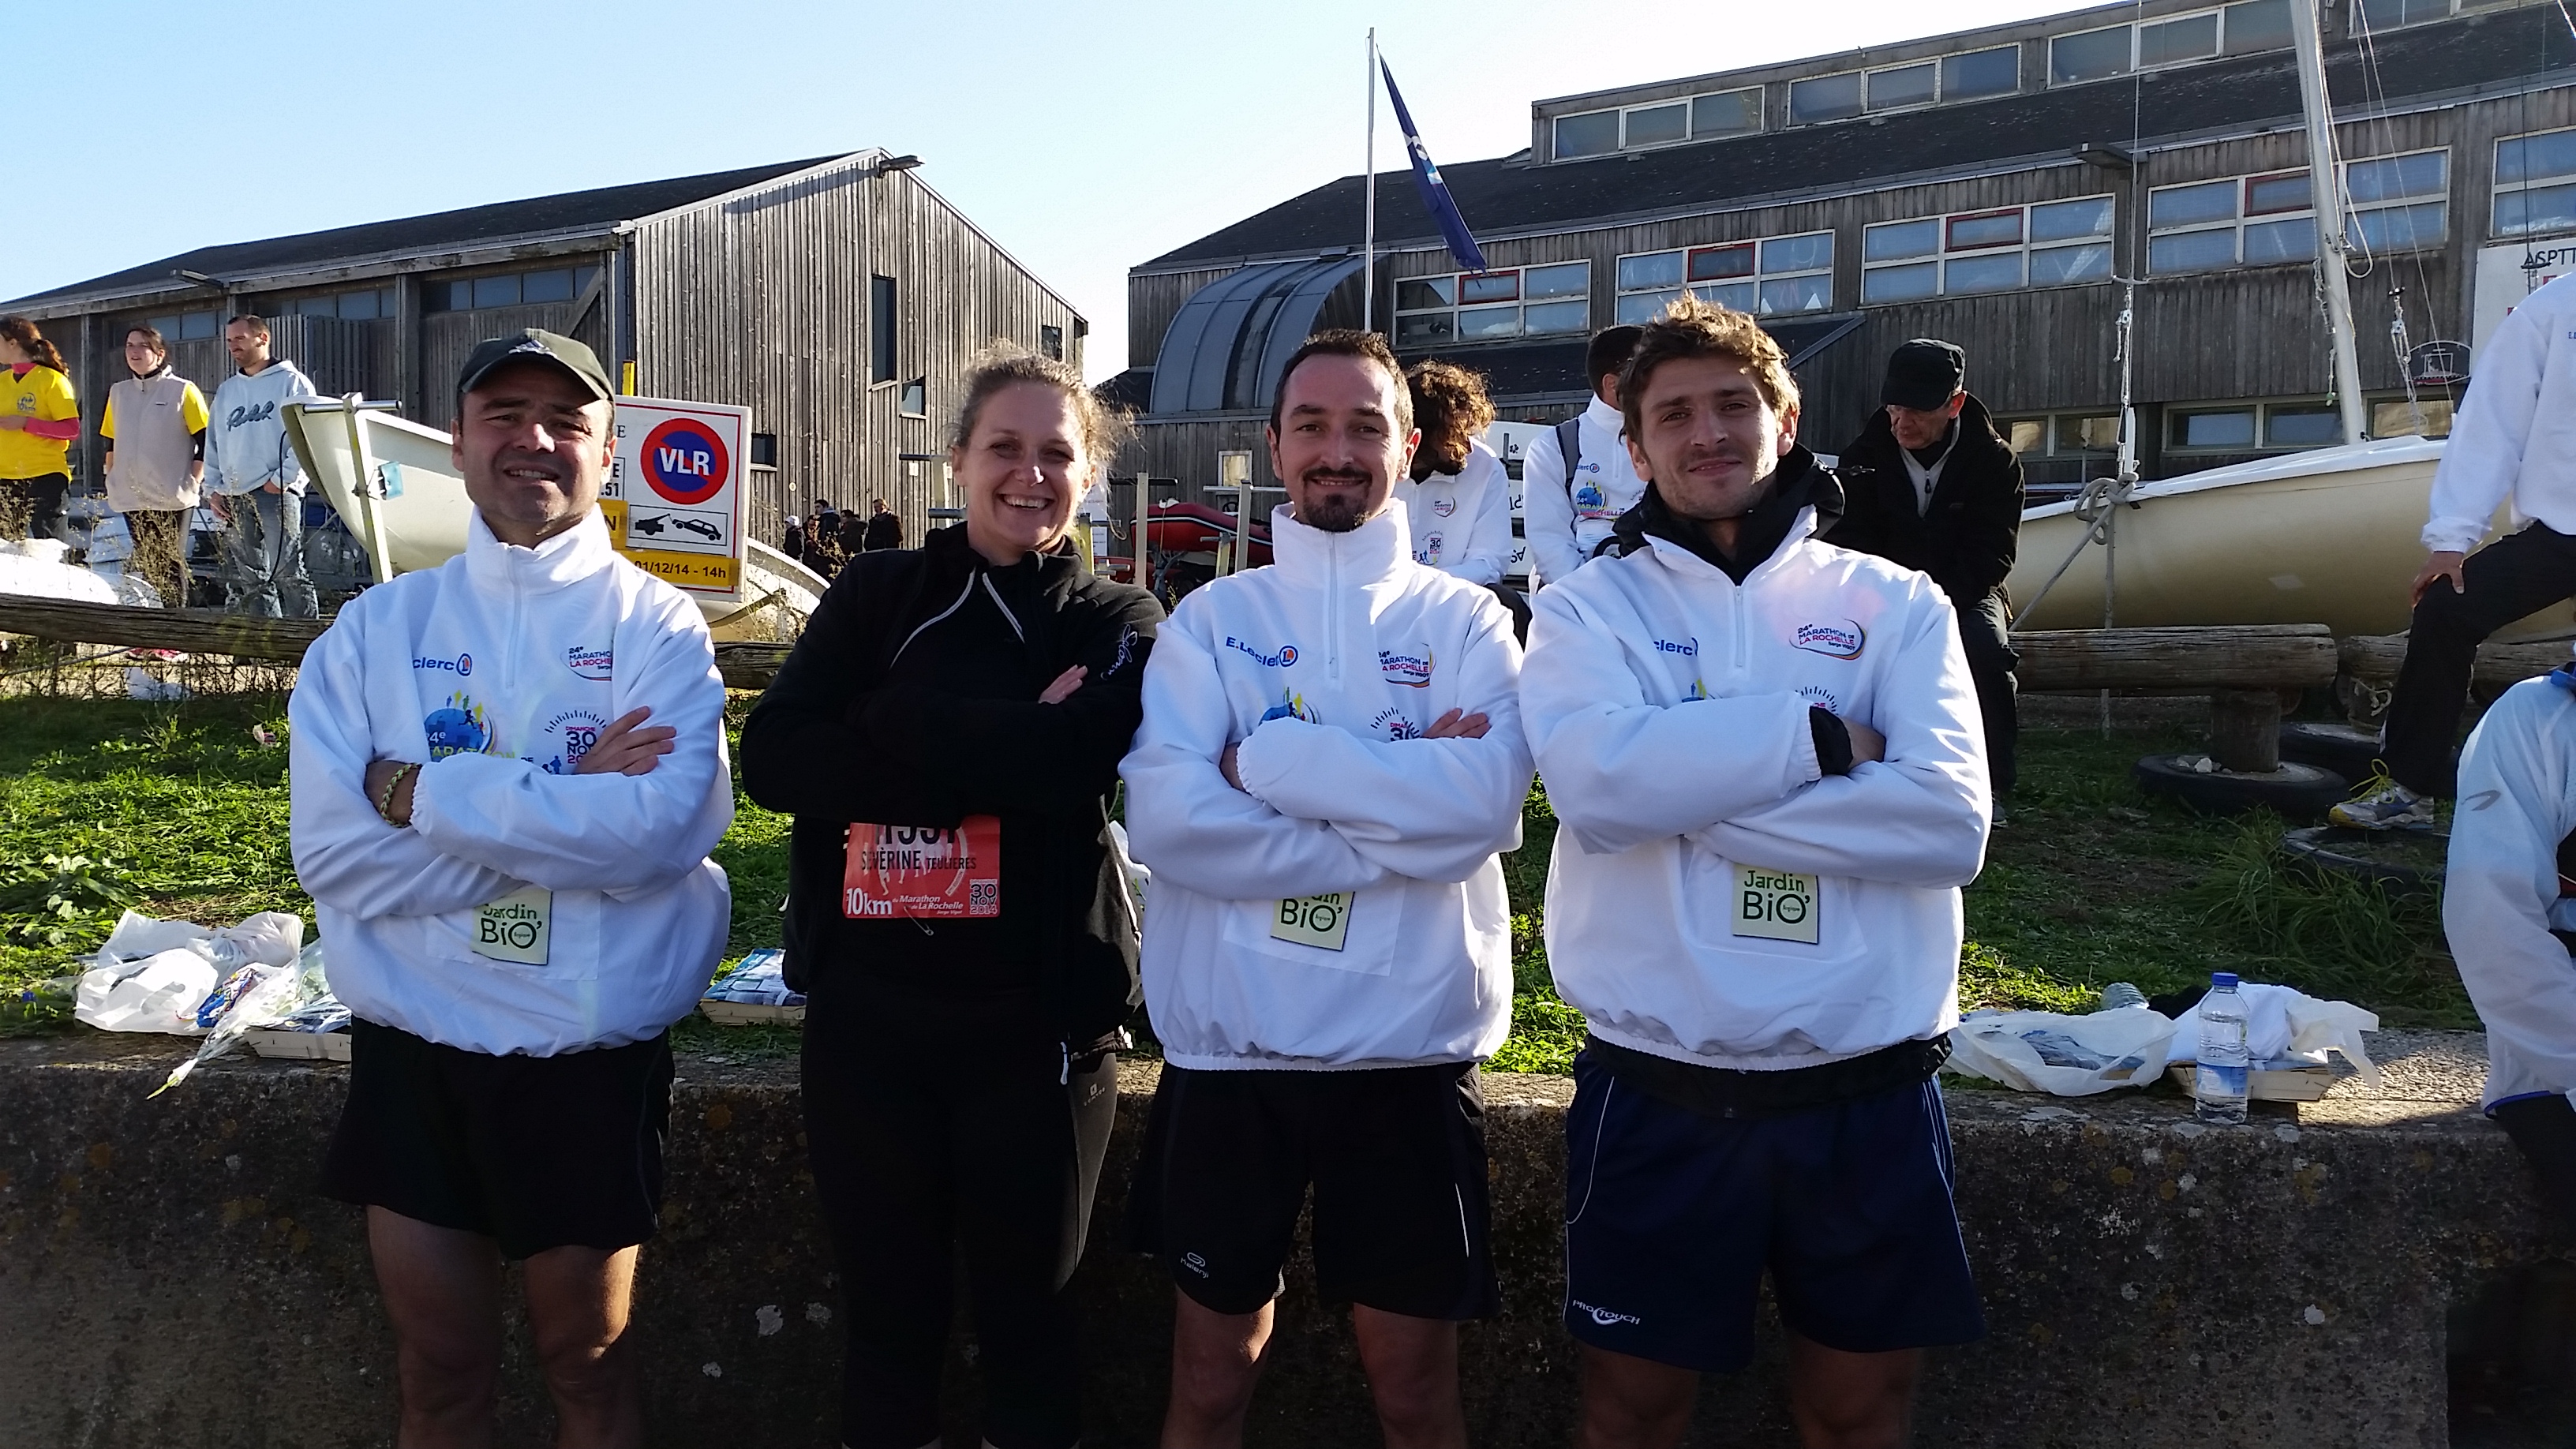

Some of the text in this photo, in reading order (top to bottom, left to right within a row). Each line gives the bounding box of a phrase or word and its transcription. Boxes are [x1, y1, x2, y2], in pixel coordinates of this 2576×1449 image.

[660, 447, 710, 476] VLR
[703, 565, 726, 578] 14h
[1799, 627, 1846, 640] MARATHON
[1799, 635, 1855, 646] LA ROCHELLE
[1389, 663, 1428, 672] ROCHELLE
[566, 731, 597, 747] 30
[567, 746, 591, 755] NO
[1743, 870, 1805, 893] Jardin
[971, 884, 996, 898] 30
[899, 894, 941, 903] Marathon
[971, 897, 996, 905] NOV
[927, 901, 964, 910] Rochelle
[971, 905, 996, 914] 2014
